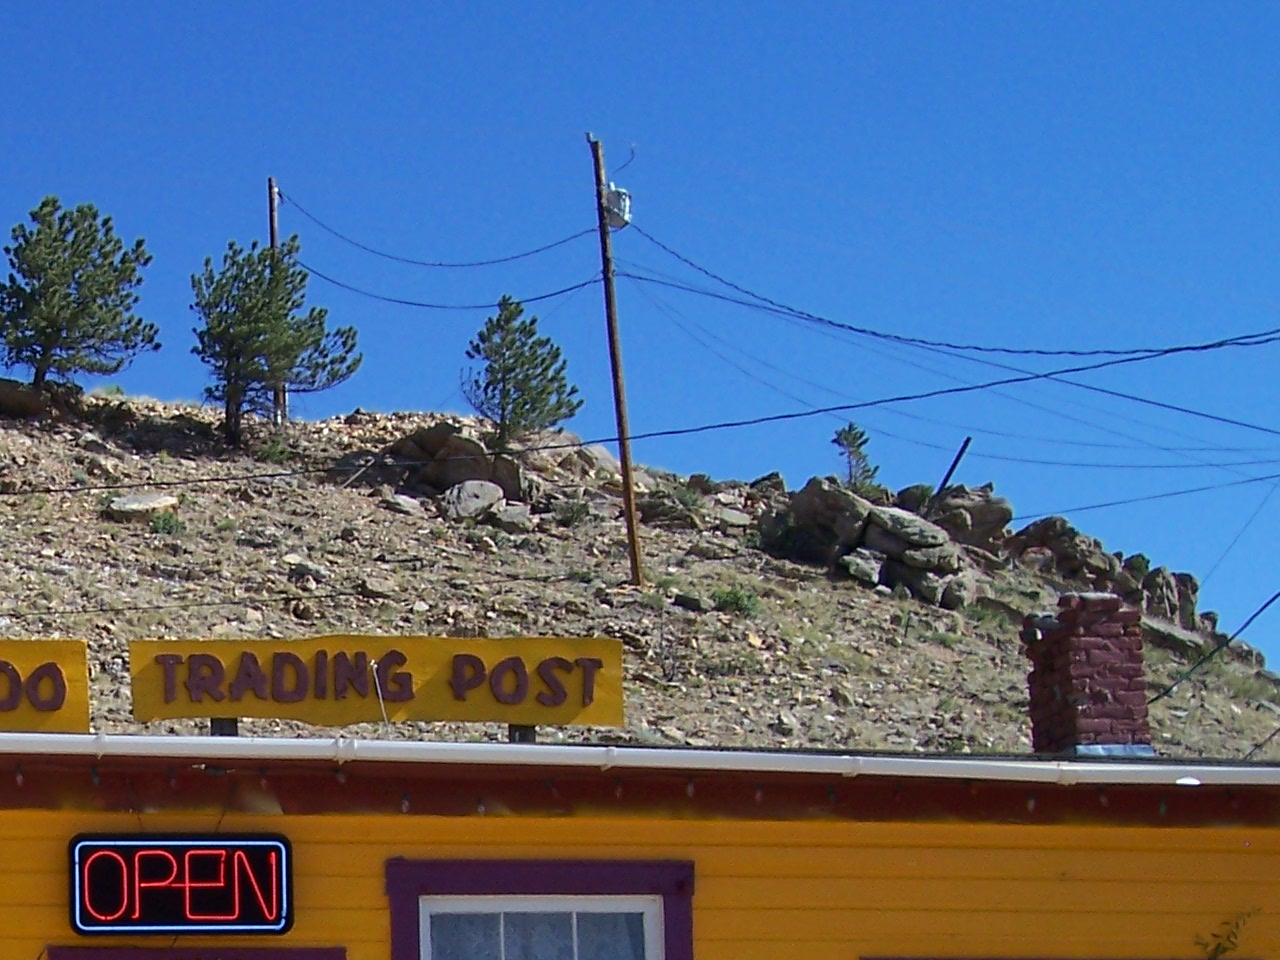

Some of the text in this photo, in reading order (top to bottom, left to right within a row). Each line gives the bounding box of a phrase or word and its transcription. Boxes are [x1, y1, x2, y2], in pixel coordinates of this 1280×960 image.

[155, 648, 605, 707] TRADING POST
[83, 849, 277, 921] OPEN
